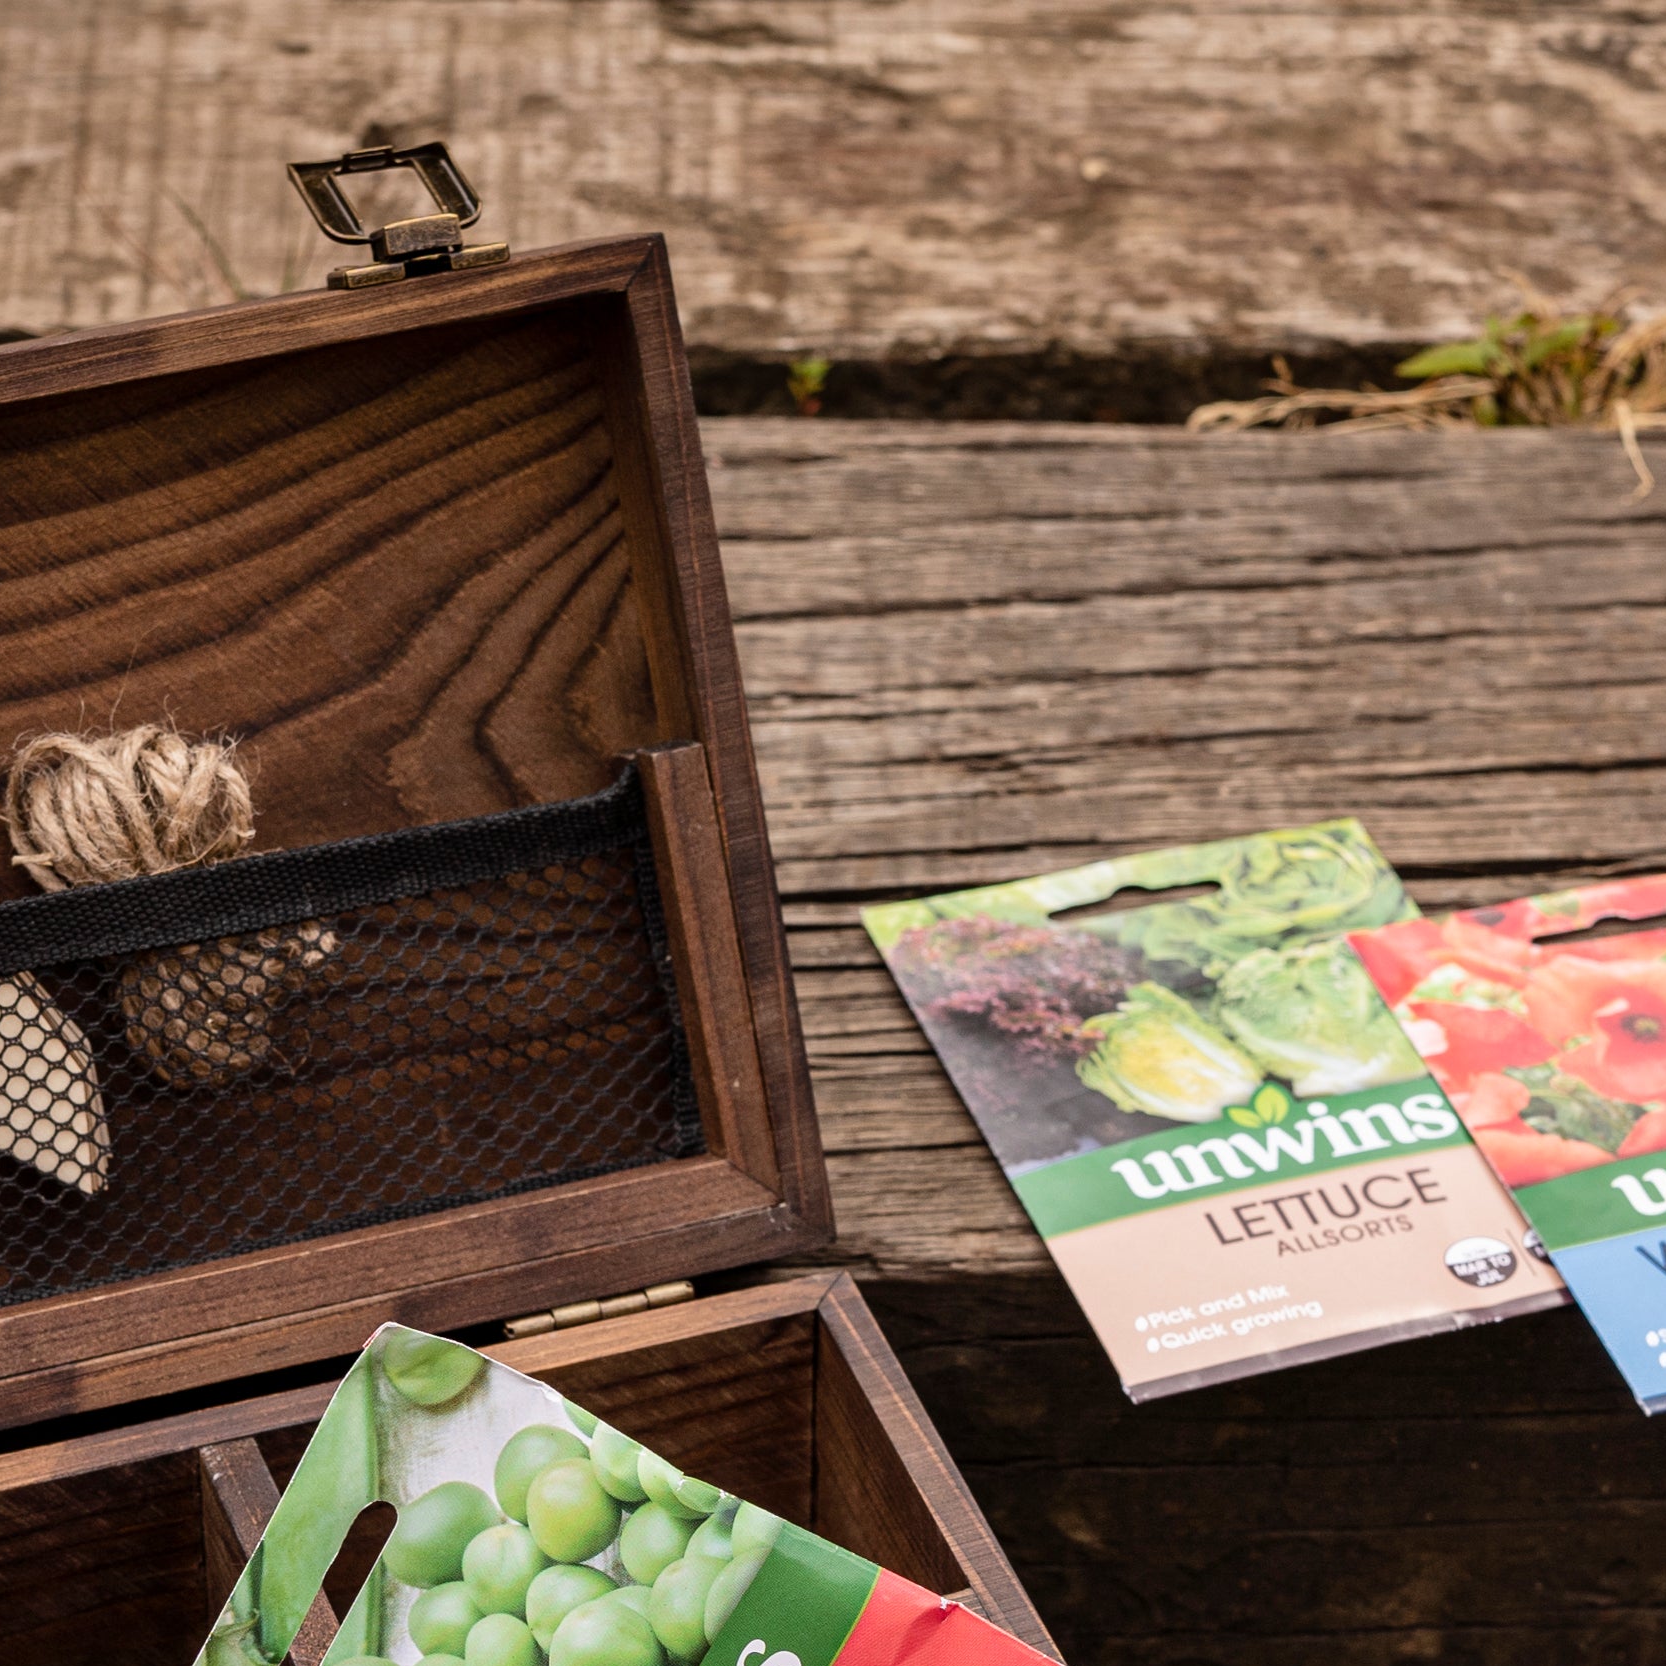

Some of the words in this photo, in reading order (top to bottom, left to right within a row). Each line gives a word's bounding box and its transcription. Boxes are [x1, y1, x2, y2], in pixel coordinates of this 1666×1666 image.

[1110, 1093, 1460, 1199] unwins
[1204, 1167, 1448, 1245] LETTUCE
[1276, 1214, 1414, 1258] ALLSORTS
[1453, 1259, 1489, 1277] MAR
[1488, 1253, 1512, 1268] TO
[1476, 1269, 1506, 1287] JUL
[1147, 1306, 1196, 1329] Pick
[1199, 1292, 1247, 1316] and
[1247, 1284, 1290, 1305] Mix
[1160, 1322, 1228, 1349] Quick
[1230, 1300, 1323, 1336] growing
